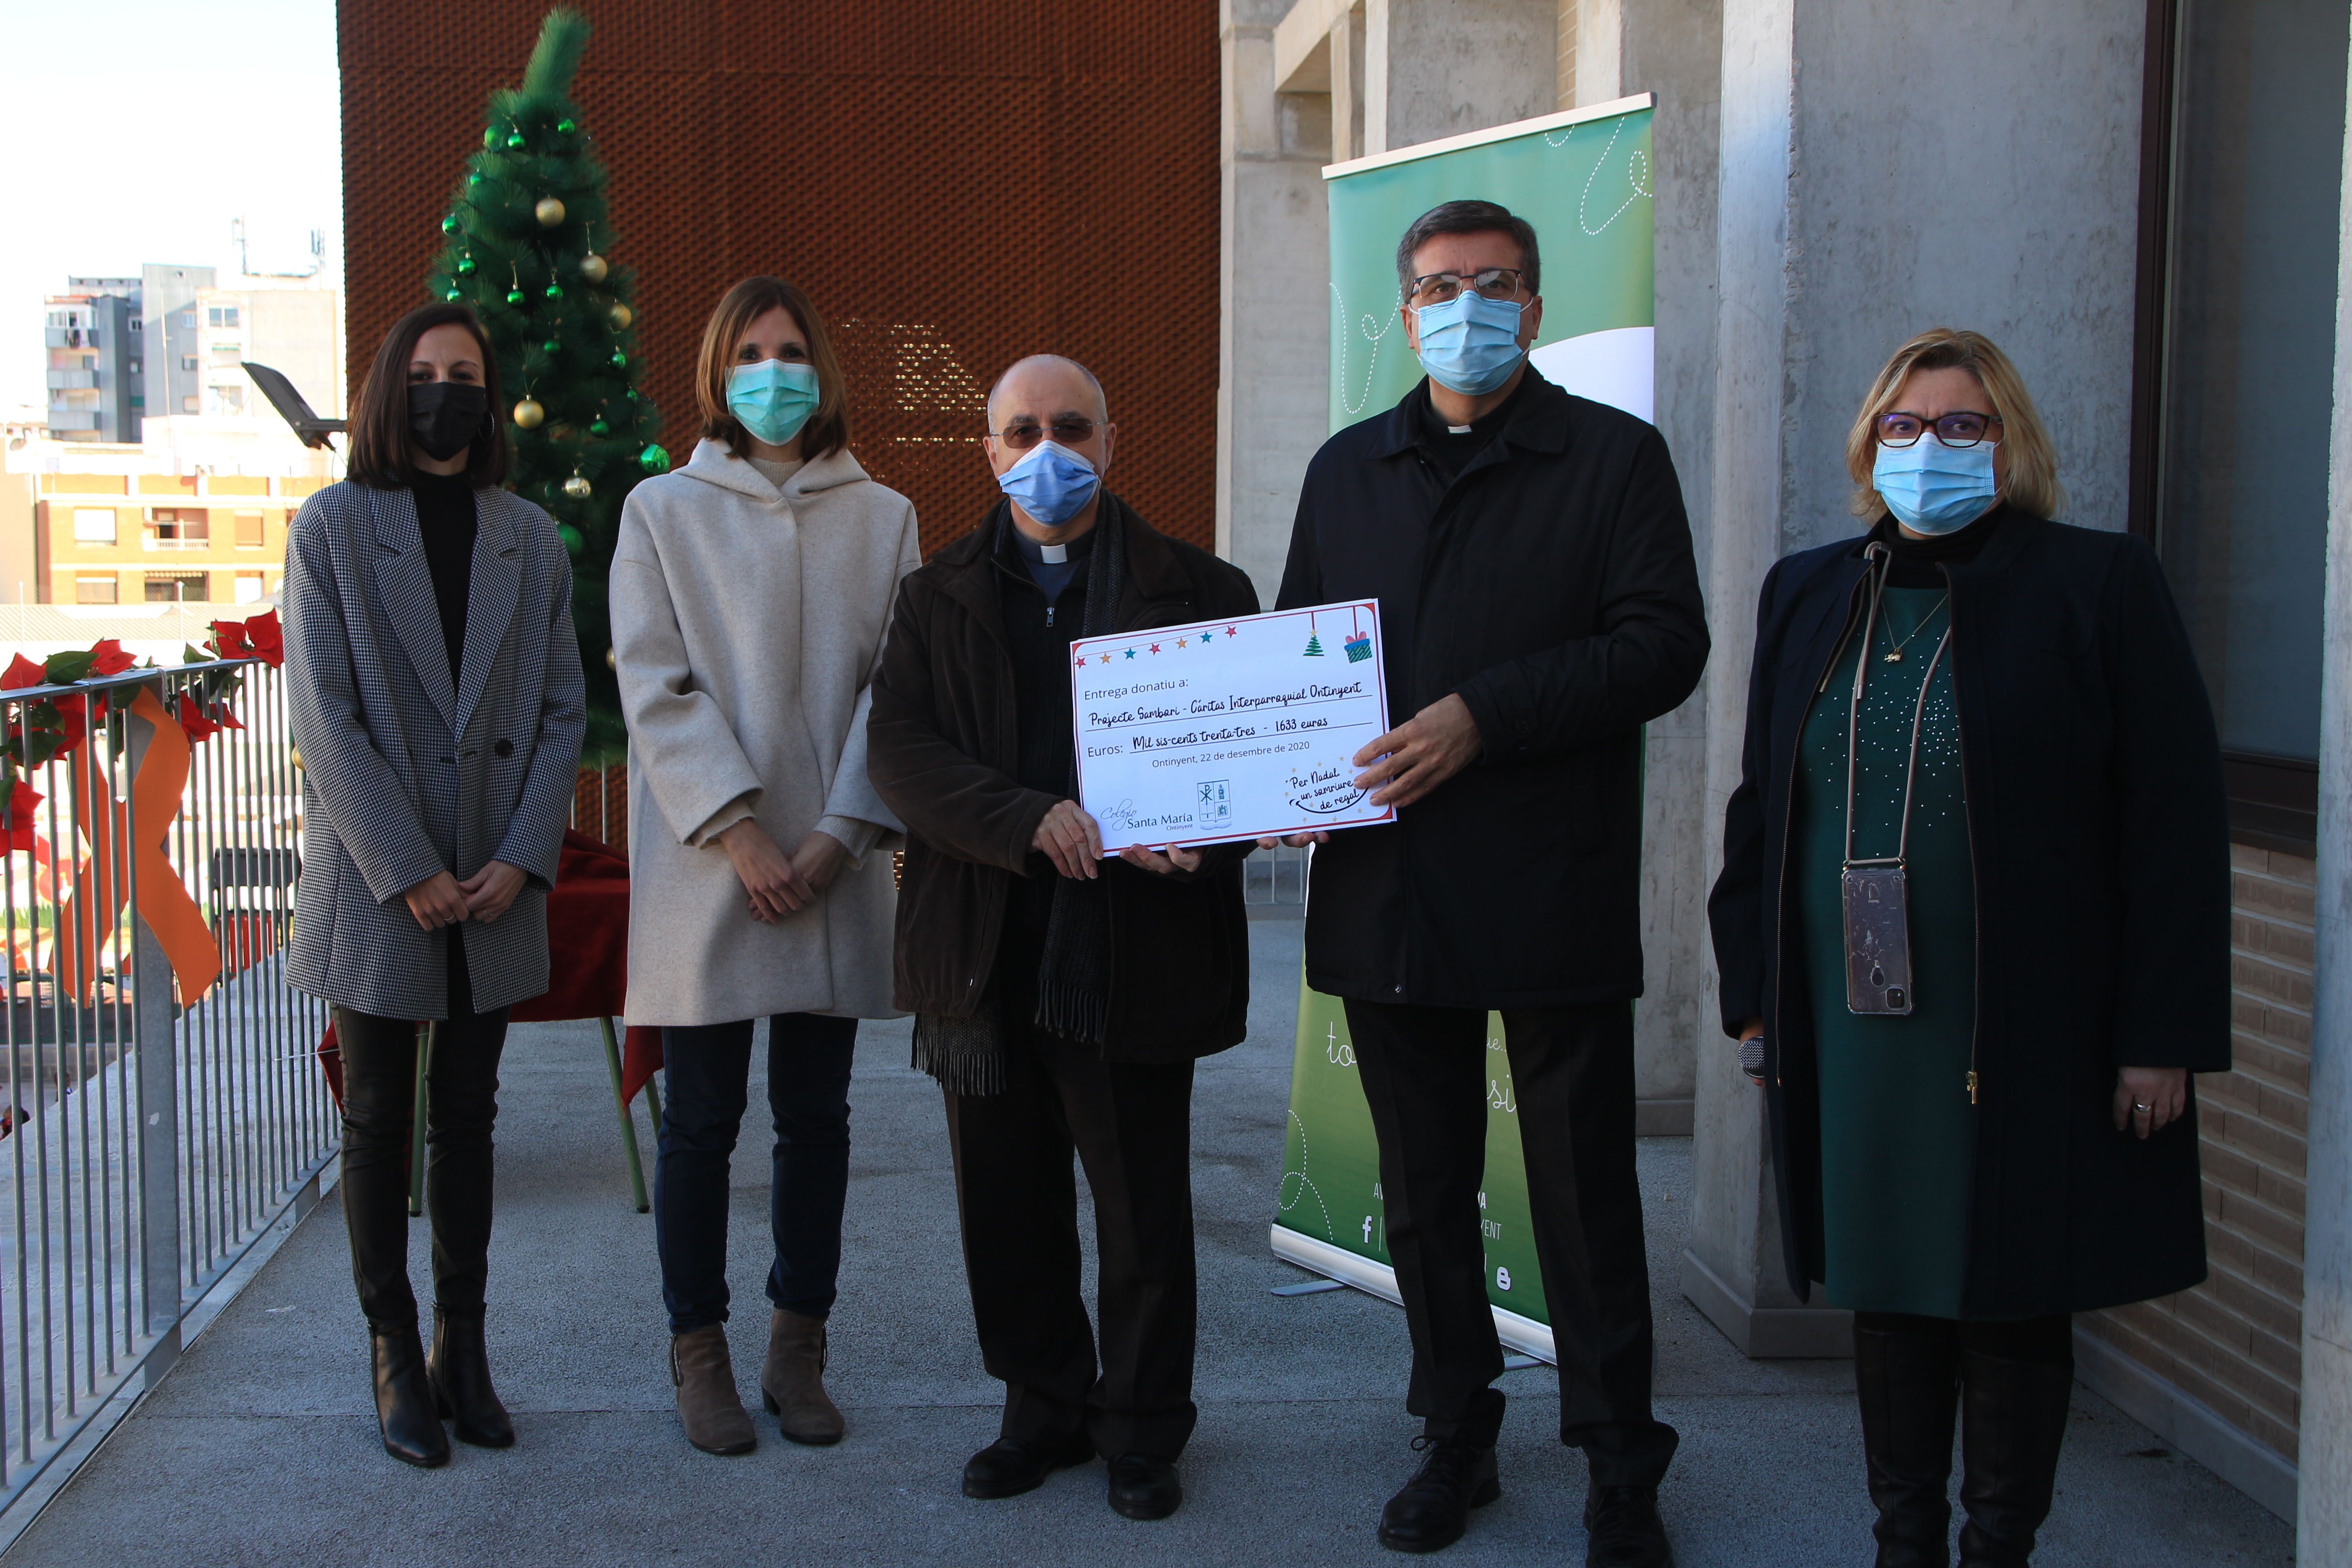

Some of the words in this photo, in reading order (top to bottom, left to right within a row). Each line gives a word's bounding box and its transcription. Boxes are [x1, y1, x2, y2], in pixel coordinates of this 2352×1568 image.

[1085, 687, 1127, 700] Entrega
[1131, 679, 1175, 694] donatiu
[1179, 679, 1189, 687] a:
[1088, 712, 1135, 727] Projecte
[1137, 707, 1181, 720] Sambori
[1191, 699, 1225, 713] Cáritas
[1229, 689, 1307, 710] Interparroquial
[1310, 682, 1362, 698] Ontinyent
[1088, 745, 1123, 757] Euros:
[1133, 736, 1154, 750] Mil
[1156, 732, 1198, 746] sis-cents
[1199, 726, 1255, 740] trenta-tres
[1275, 719, 1297, 732] 1.633
[1301, 718, 1328, 728] euros
[1152, 756, 1198, 768] Ontinyent,
[1200, 754, 1211, 763] 22
[1214, 752, 1225, 760] de
[1227, 747, 1271, 759] desembre
[1274, 745, 1285, 753] de
[1288, 741, 1310, 751] 2020
[1289, 777, 1308, 789] Per
[1314, 780, 1353, 797] somriure
[1320, 800, 1333, 810] de
[1335, 789, 1360, 805] regal
[1127, 818, 1157, 829] Santa
[1161, 813, 1193, 825] María
[1326, 1021, 1357, 1067] to
